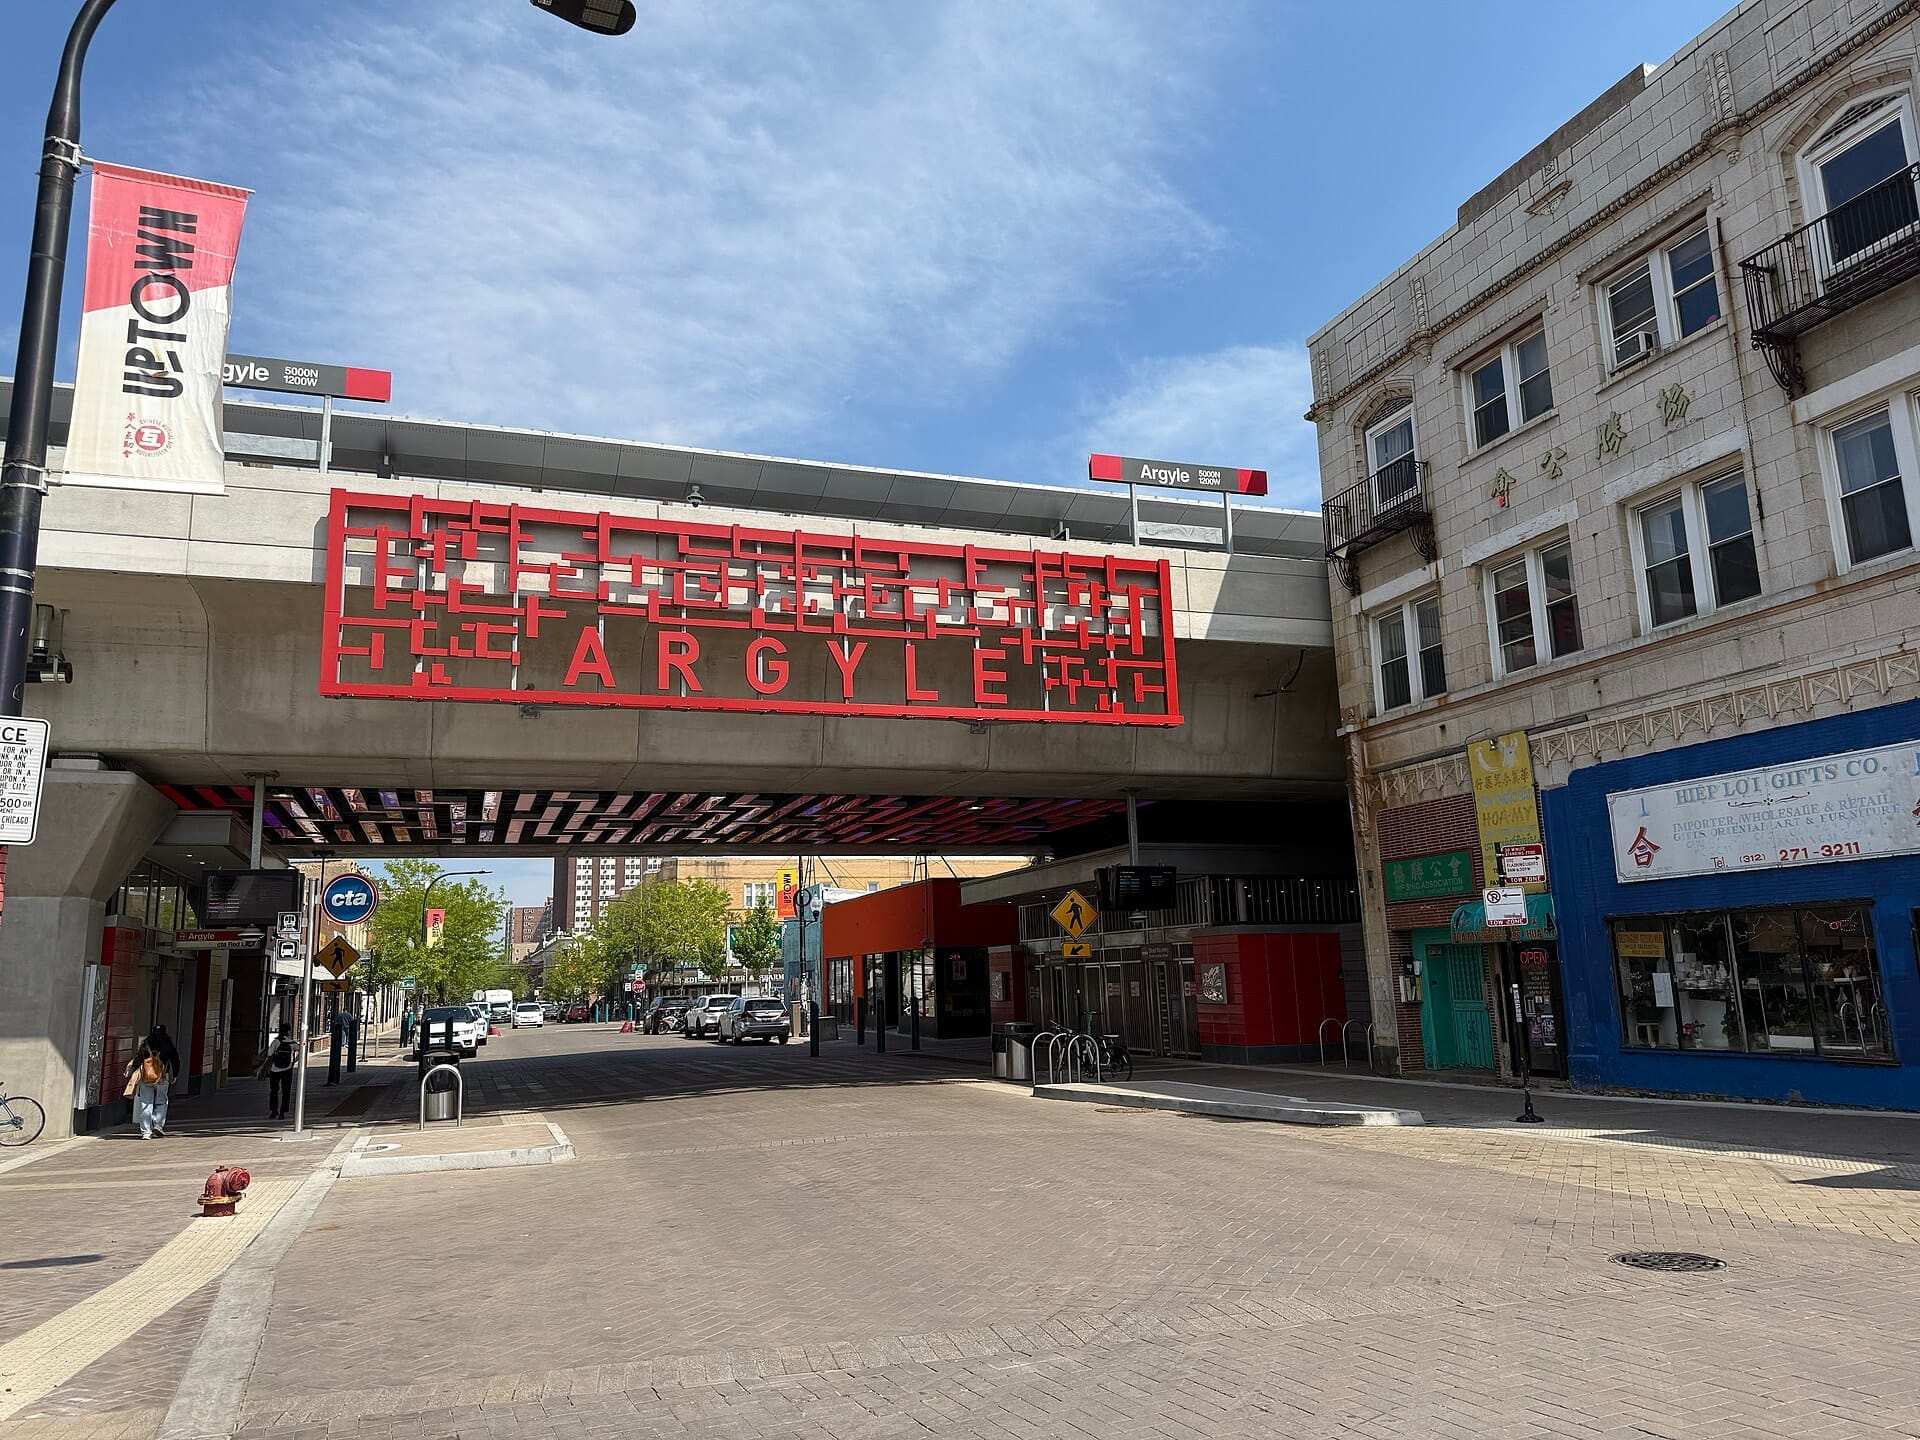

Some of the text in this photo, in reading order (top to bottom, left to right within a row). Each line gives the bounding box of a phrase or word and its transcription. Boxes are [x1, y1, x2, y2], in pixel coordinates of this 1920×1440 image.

[123, 205, 198, 398] UPTOWN
[223, 362, 270, 383] gyle
[284, 366, 319, 378] 5000N
[283, 375, 318, 387] 1200W
[1140, 464, 1190, 485] Argyle
[1198, 477, 1221, 486] 1200W
[563, 625, 1008, 705] ARGYLE
[20, 747, 34, 755] ANY
[14, 754, 28, 762] ANY
[26, 769, 32, 777] A
[12, 782, 28, 790] CITY
[21, 776, 27, 784] A
[1674, 784, 1717, 805] HIEP
[1771, 763, 1838, 789] GIFTS
[0, 797, 33, 809] 500 OR
[1823, 800, 1834, 813] &
[1839, 794, 1893, 809] RETAIL
[2, 815, 29, 825] CHICAGO
[1774, 817, 1801, 829] ART
[1805, 815, 1815, 825] &
[1627, 826, 1662, 868] 合
[1710, 856, 1729, 870] Tel.
[1739, 853, 1766, 864] (312)
[1779, 841, 1862, 862] 271-3211
[783, 873, 792, 904] UPTOWN
[1420, 876, 1463, 889] ASSOCIATION
[331, 891, 368, 907] cta
[188, 932, 215, 942] Argyle
[1520, 951, 1548, 964] OPEN
